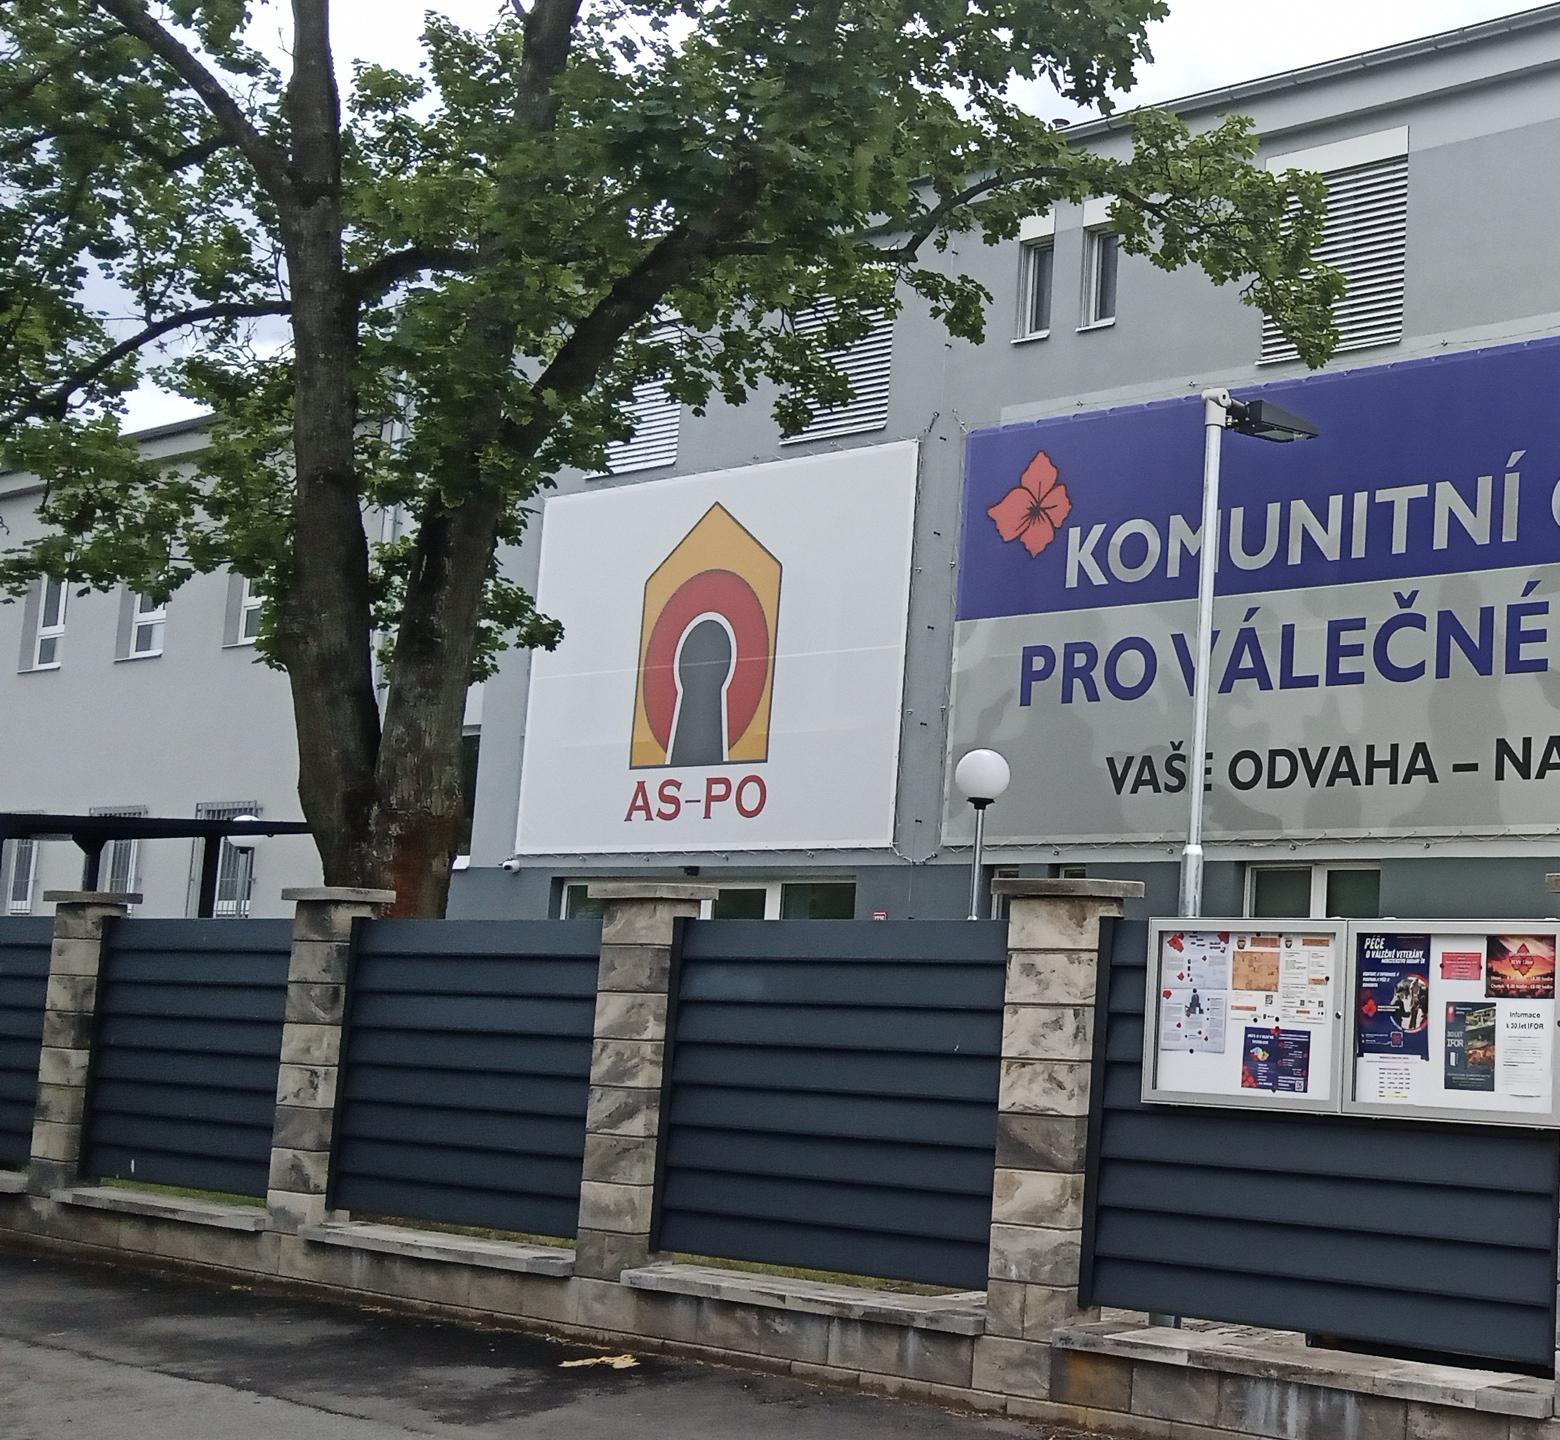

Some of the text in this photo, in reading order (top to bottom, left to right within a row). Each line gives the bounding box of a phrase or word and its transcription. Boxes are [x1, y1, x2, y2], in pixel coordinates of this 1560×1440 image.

[1065, 450, 1527, 588] KOMUNITNÍ
[1019, 637, 1157, 707] PRO
[1171, 580, 1549, 697] VÁLEČNÉ
[1228, 741, 1439, 791] ODVAHA
[624, 774, 768, 822] AS-PO
[1364, 935, 1386, 950] PÉČE
